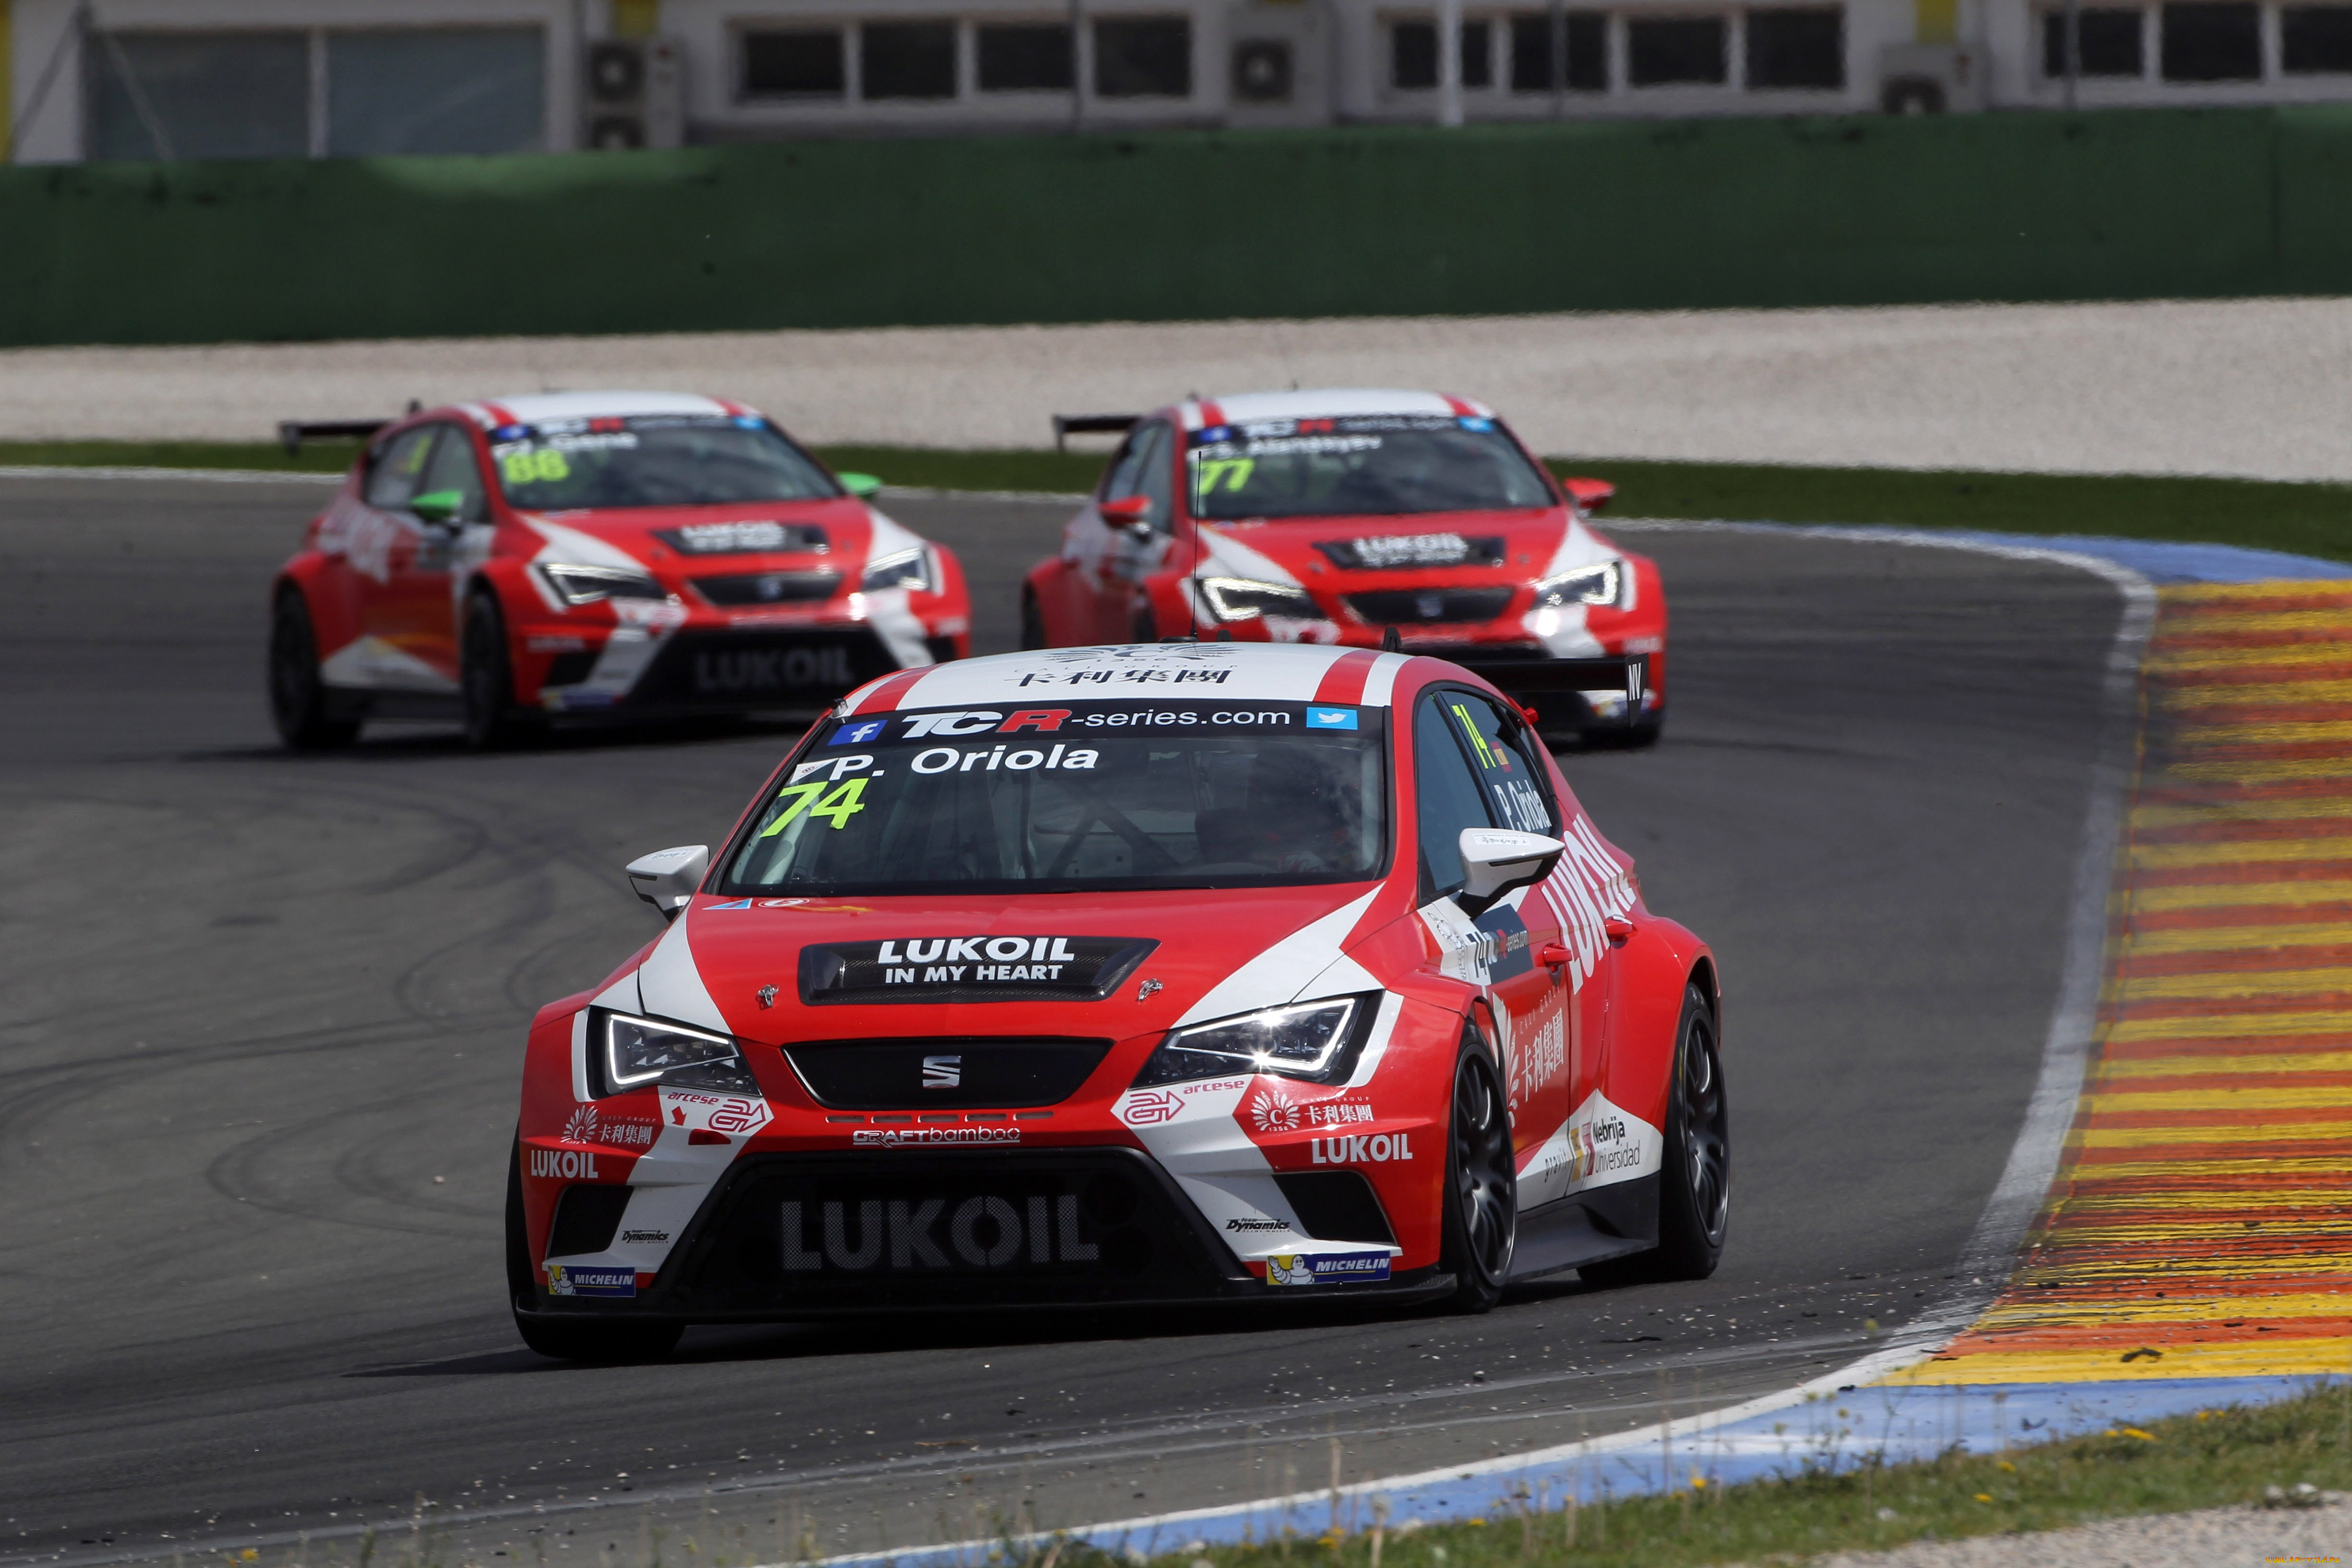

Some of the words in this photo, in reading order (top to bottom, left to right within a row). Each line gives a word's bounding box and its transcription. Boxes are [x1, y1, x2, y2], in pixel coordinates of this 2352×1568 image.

[1193, 458, 1255, 495] 77
[694, 645, 854, 690] LUKOIL
[1004, 669, 1232, 687] 卡利集團
[1452, 704, 1496, 769] 74
[829, 754, 885, 781] P.
[911, 744, 1099, 774] Oriola
[759, 778, 869, 838] 74
[1507, 779, 1552, 832] Oriola
[1541, 813, 1637, 995] LUKOIL
[878, 937, 1074, 964] LUKOIL
[885, 967, 914, 984] IN
[923, 966, 967, 982] MY
[976, 965, 1062, 981] HEART
[1522, 1007, 1564, 1102] 卡利集團
[667, 1091, 719, 1105] arcese
[1183, 1079, 1245, 1094] arcese
[1305, 1104, 1374, 1124] 卡利集團
[599, 1124, 653, 1145] 卡利集團
[1593, 1116, 1625, 1145] Nebrija
[1311, 1133, 1413, 1164] LUKOIL
[1595, 1139, 1641, 1174] Universidad
[531, 1149, 598, 1179] LUKOIL
[621, 1230, 670, 1244] Dynamics
[781, 1194, 1100, 1270] LUKOIL
[1225, 1218, 1291, 1233] Dynamics
[1315, 1257, 1390, 1272] MICHELIN
[574, 1273, 634, 1286] MICHELIN
